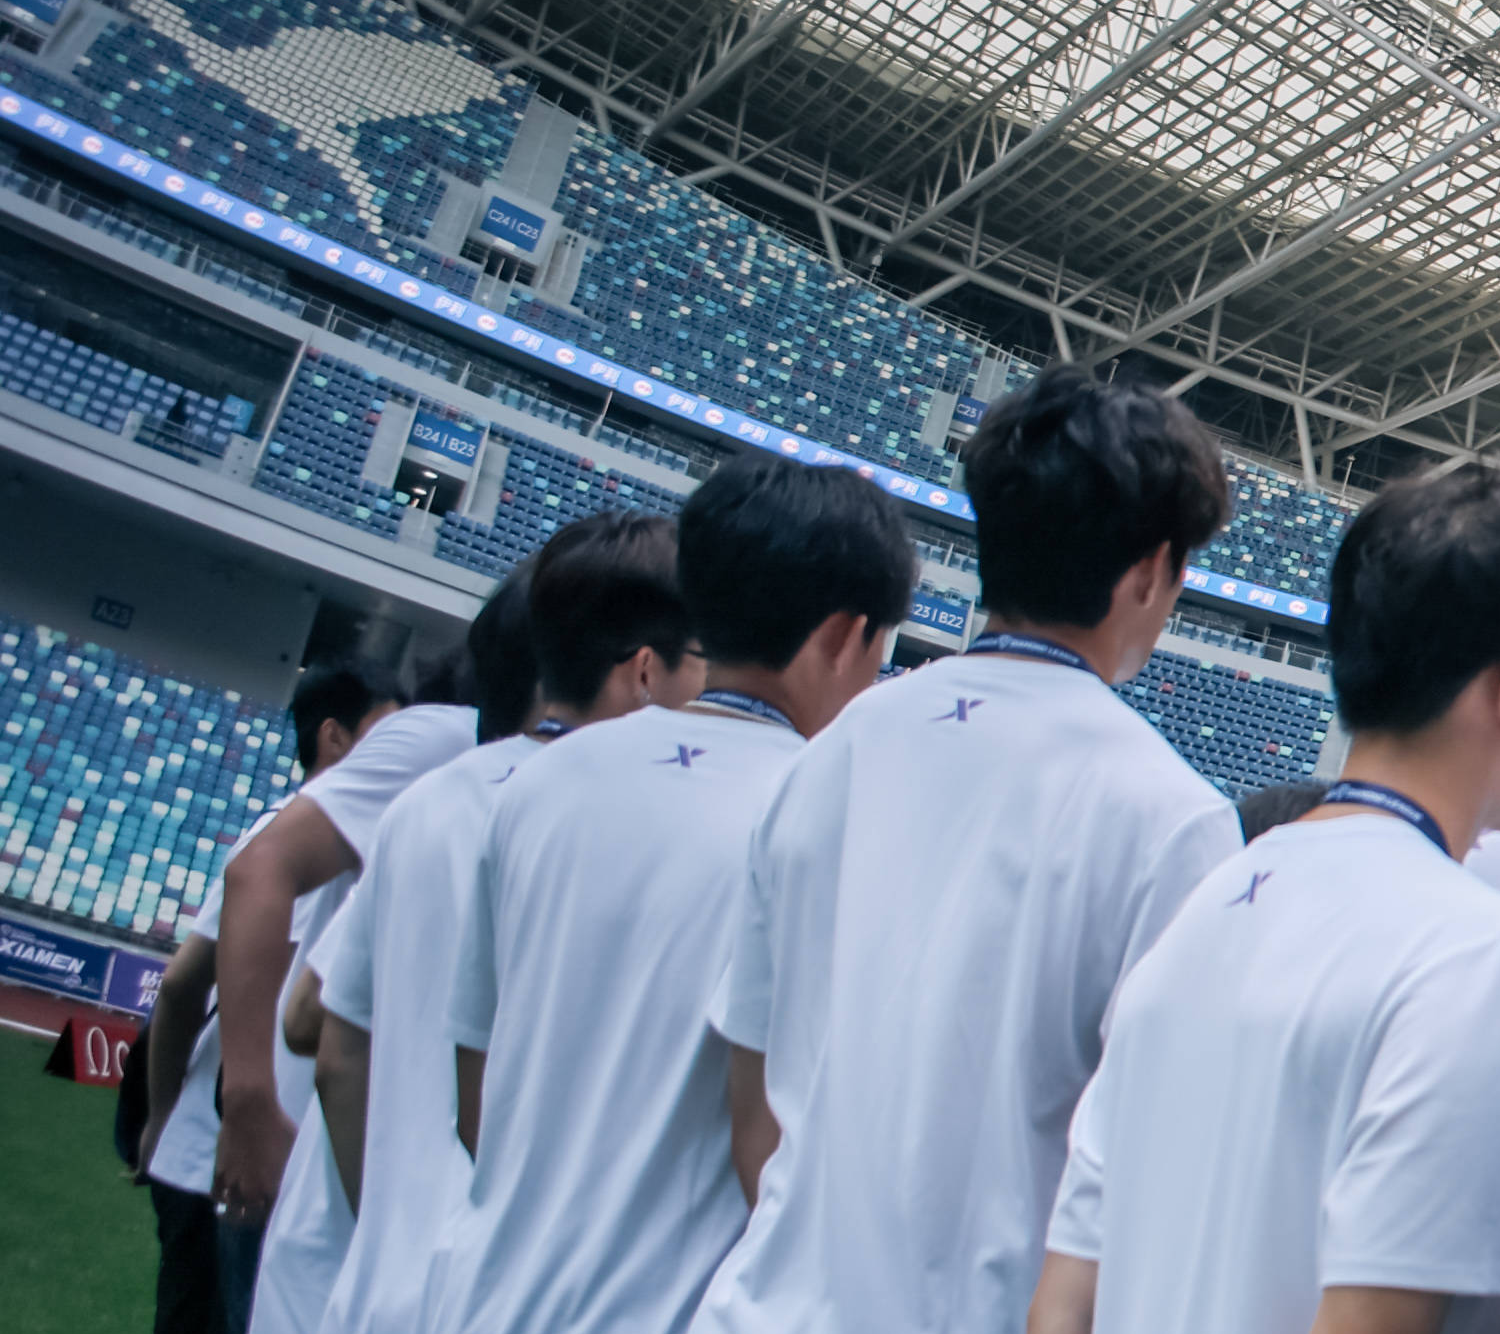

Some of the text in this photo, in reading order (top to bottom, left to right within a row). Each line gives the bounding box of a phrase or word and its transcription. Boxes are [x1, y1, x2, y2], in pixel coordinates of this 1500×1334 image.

[488, 208, 539, 240] C24 C23
[413, 423, 476, 458] B24 B23
[911, 603, 964, 629] 23 B22
[0, 938, 86, 975] XIAMEN
